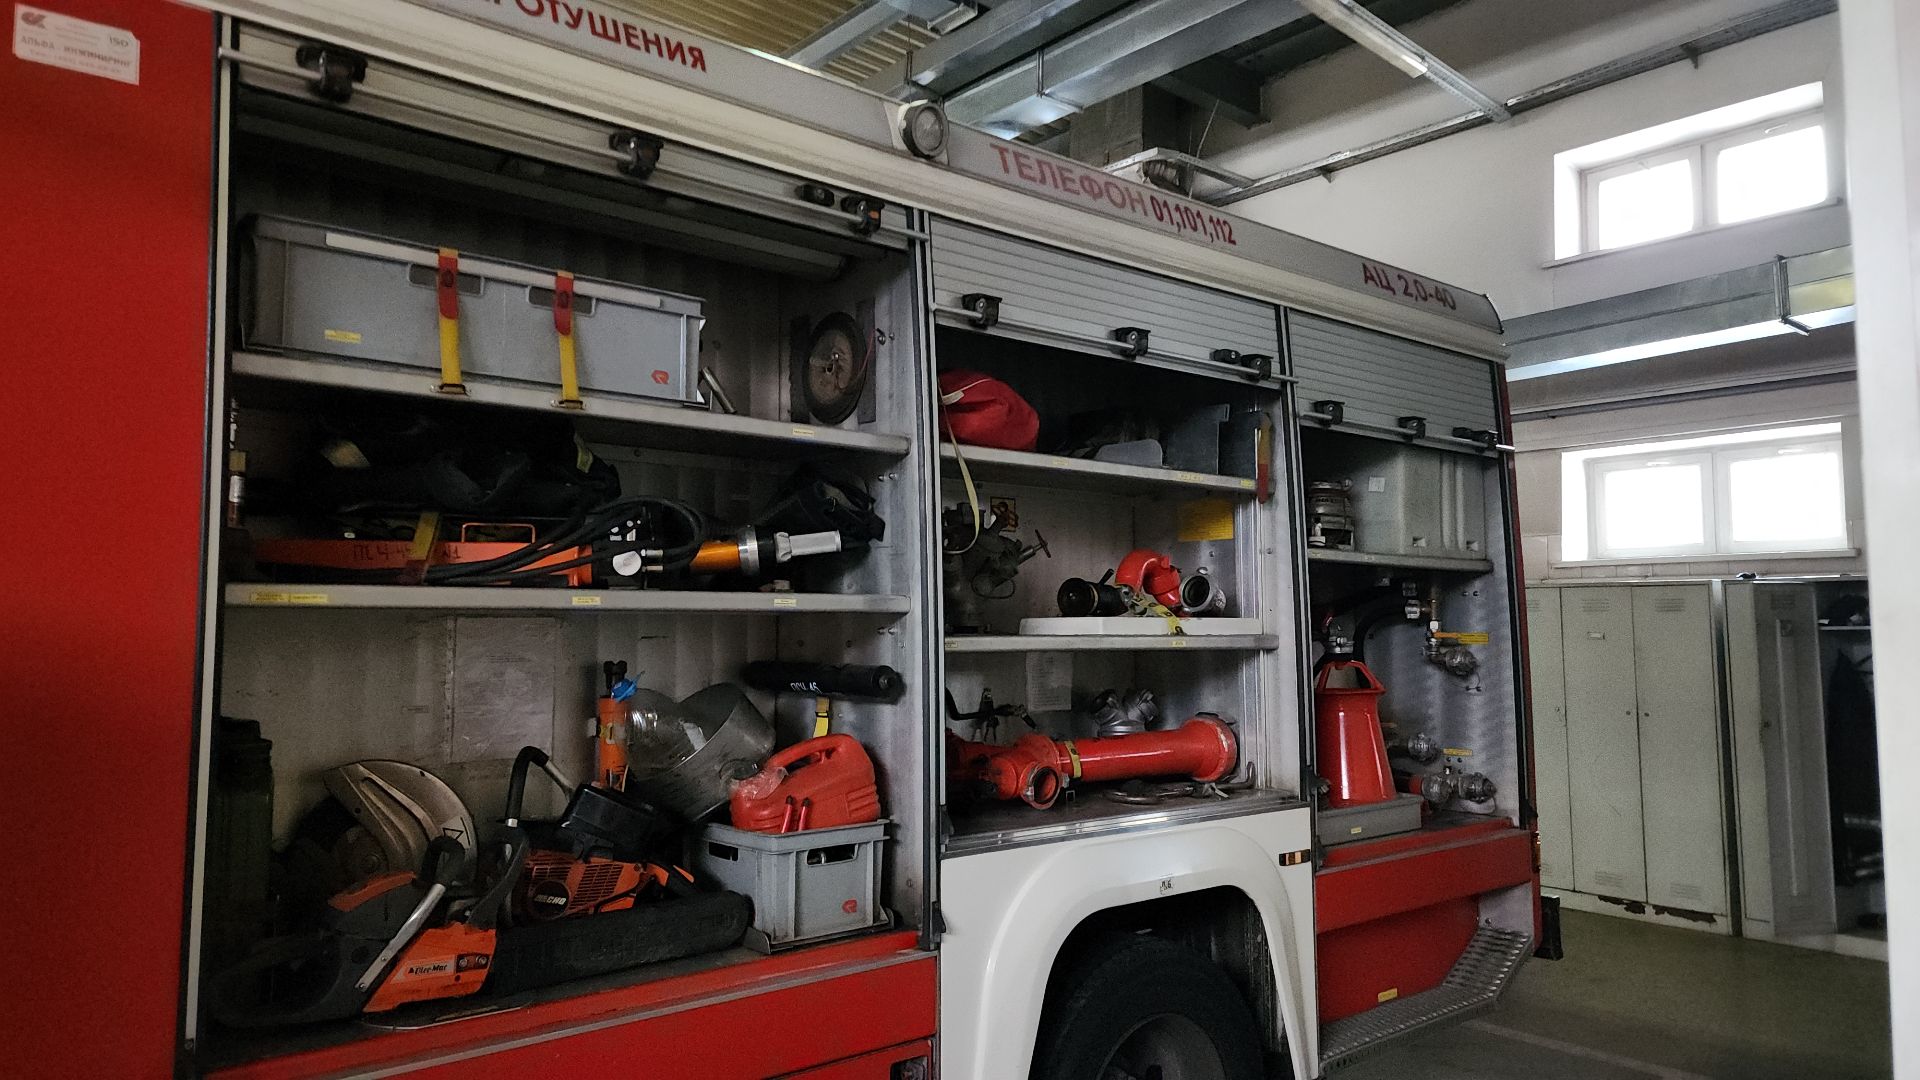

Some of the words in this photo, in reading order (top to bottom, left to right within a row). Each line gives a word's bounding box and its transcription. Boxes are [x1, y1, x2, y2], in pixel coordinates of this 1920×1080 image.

[483, 0, 707, 72] ОТУШЕНИЯ
[989, 142, 1149, 217] ТЕЛЕФОН
[1149, 195, 1237, 245] 01,101,112
[1361, 262, 1396, 296] АЦ
[1397, 273, 1457, 311] 2,0-40
